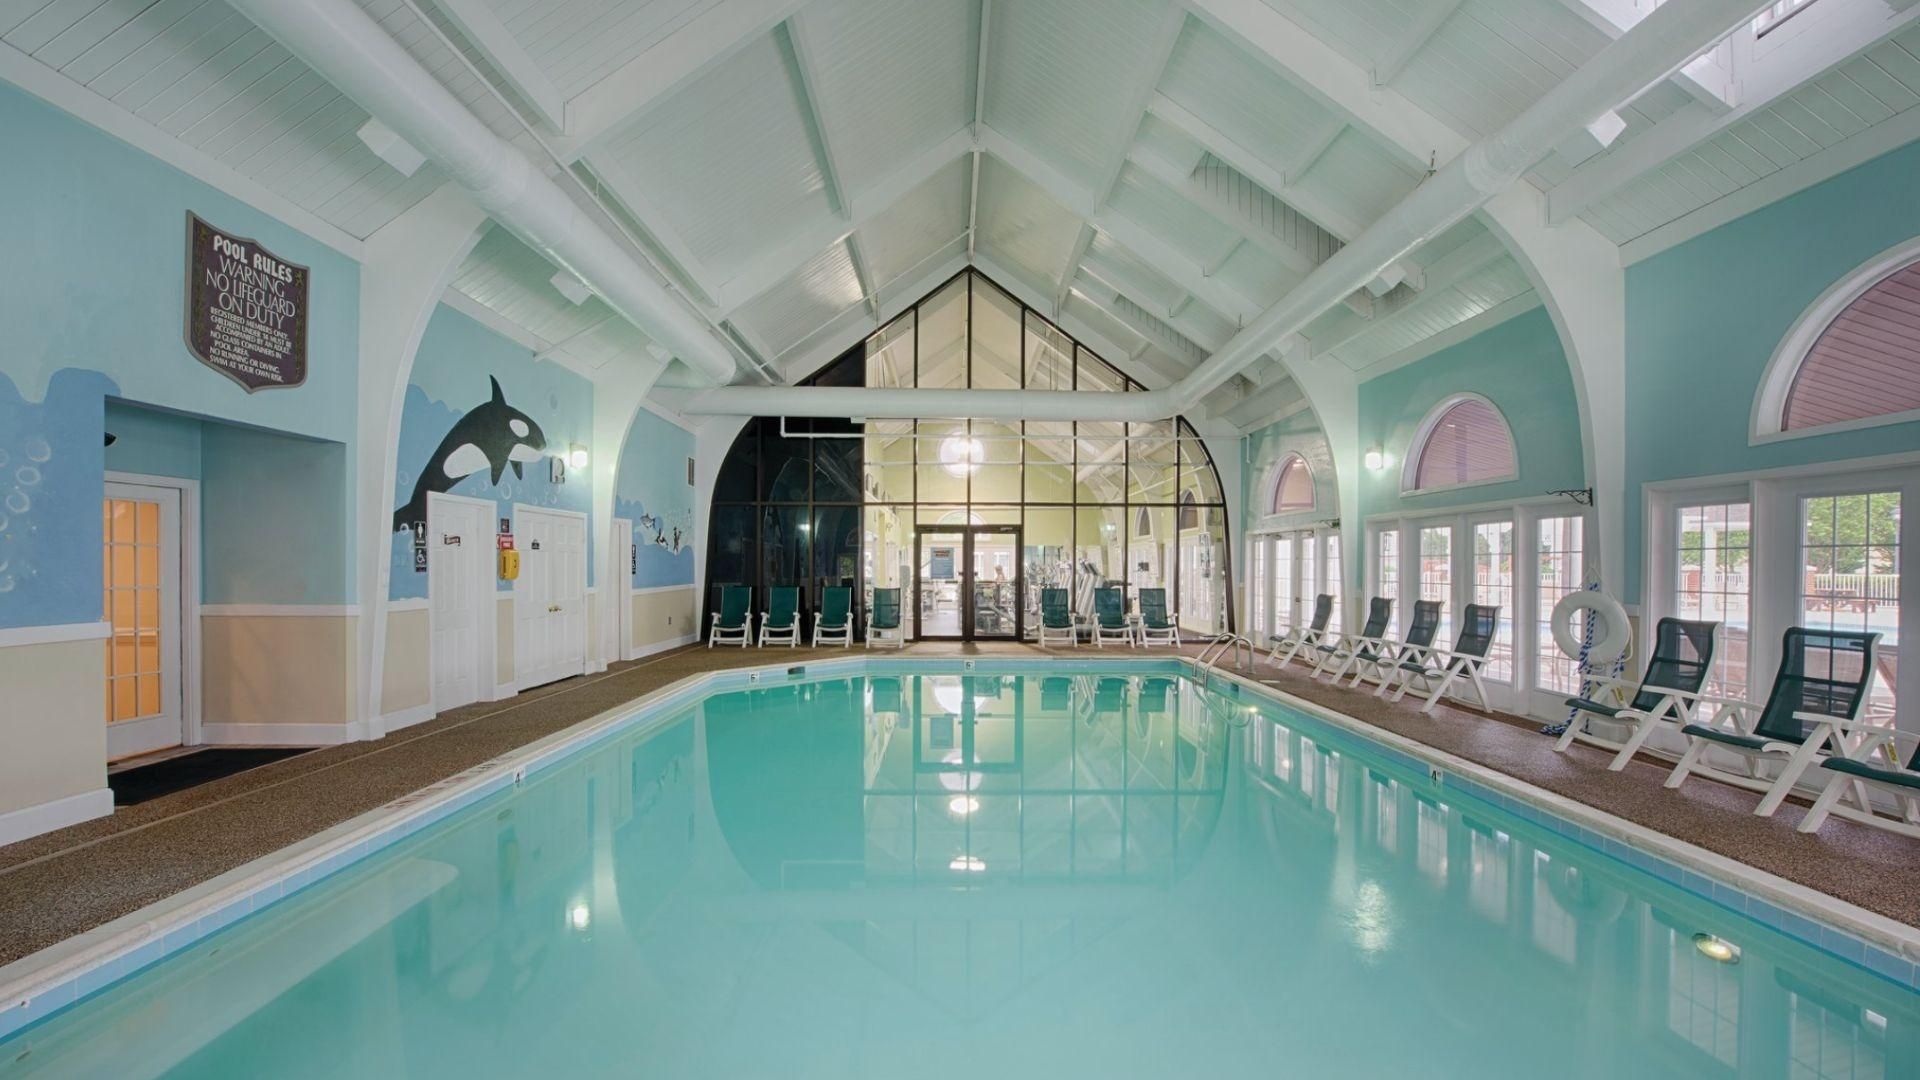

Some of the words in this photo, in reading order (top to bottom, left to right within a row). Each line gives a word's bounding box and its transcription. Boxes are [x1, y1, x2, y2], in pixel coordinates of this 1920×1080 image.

[213, 235, 248, 264] POOL
[253, 253, 293, 284] RULES
[219, 255, 285, 298] WARNING
[206, 268, 230, 292] NO
[233, 279, 296, 318] LIFEGUARD
[219, 292, 243, 315] ON
[246, 302, 285, 330] DUTY
[209, 346, 220, 355] NO
[221, 350, 249, 364] RUNNING
[249, 358, 259, 368] OR
[210, 330, 221, 340] NO
[241, 340, 275, 357] CONTAINERS
[214, 340, 232, 352] POOL
[209, 354, 228, 367] SWIM
[228, 360, 236, 369] AT
